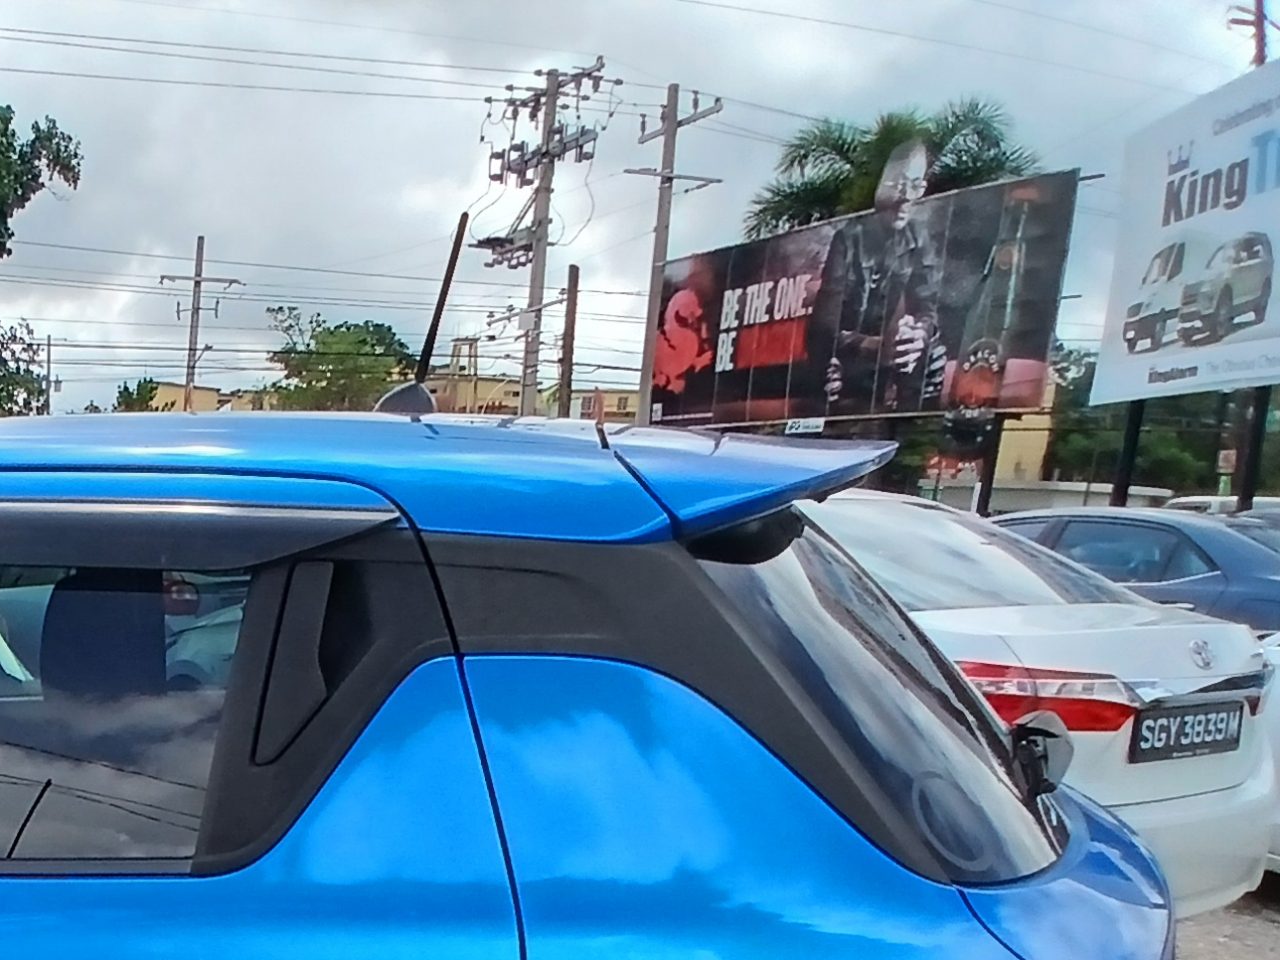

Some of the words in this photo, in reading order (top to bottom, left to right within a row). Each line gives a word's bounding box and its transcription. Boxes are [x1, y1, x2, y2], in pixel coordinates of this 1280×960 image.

[1162, 128, 1280, 228] KingT
[720, 287, 743, 331] BE
[743, 280, 775, 326] THE
[773, 273, 814, 321] ONE.
[715, 330, 737, 373] BE
[1140, 711, 1240, 750] SGY3839M
